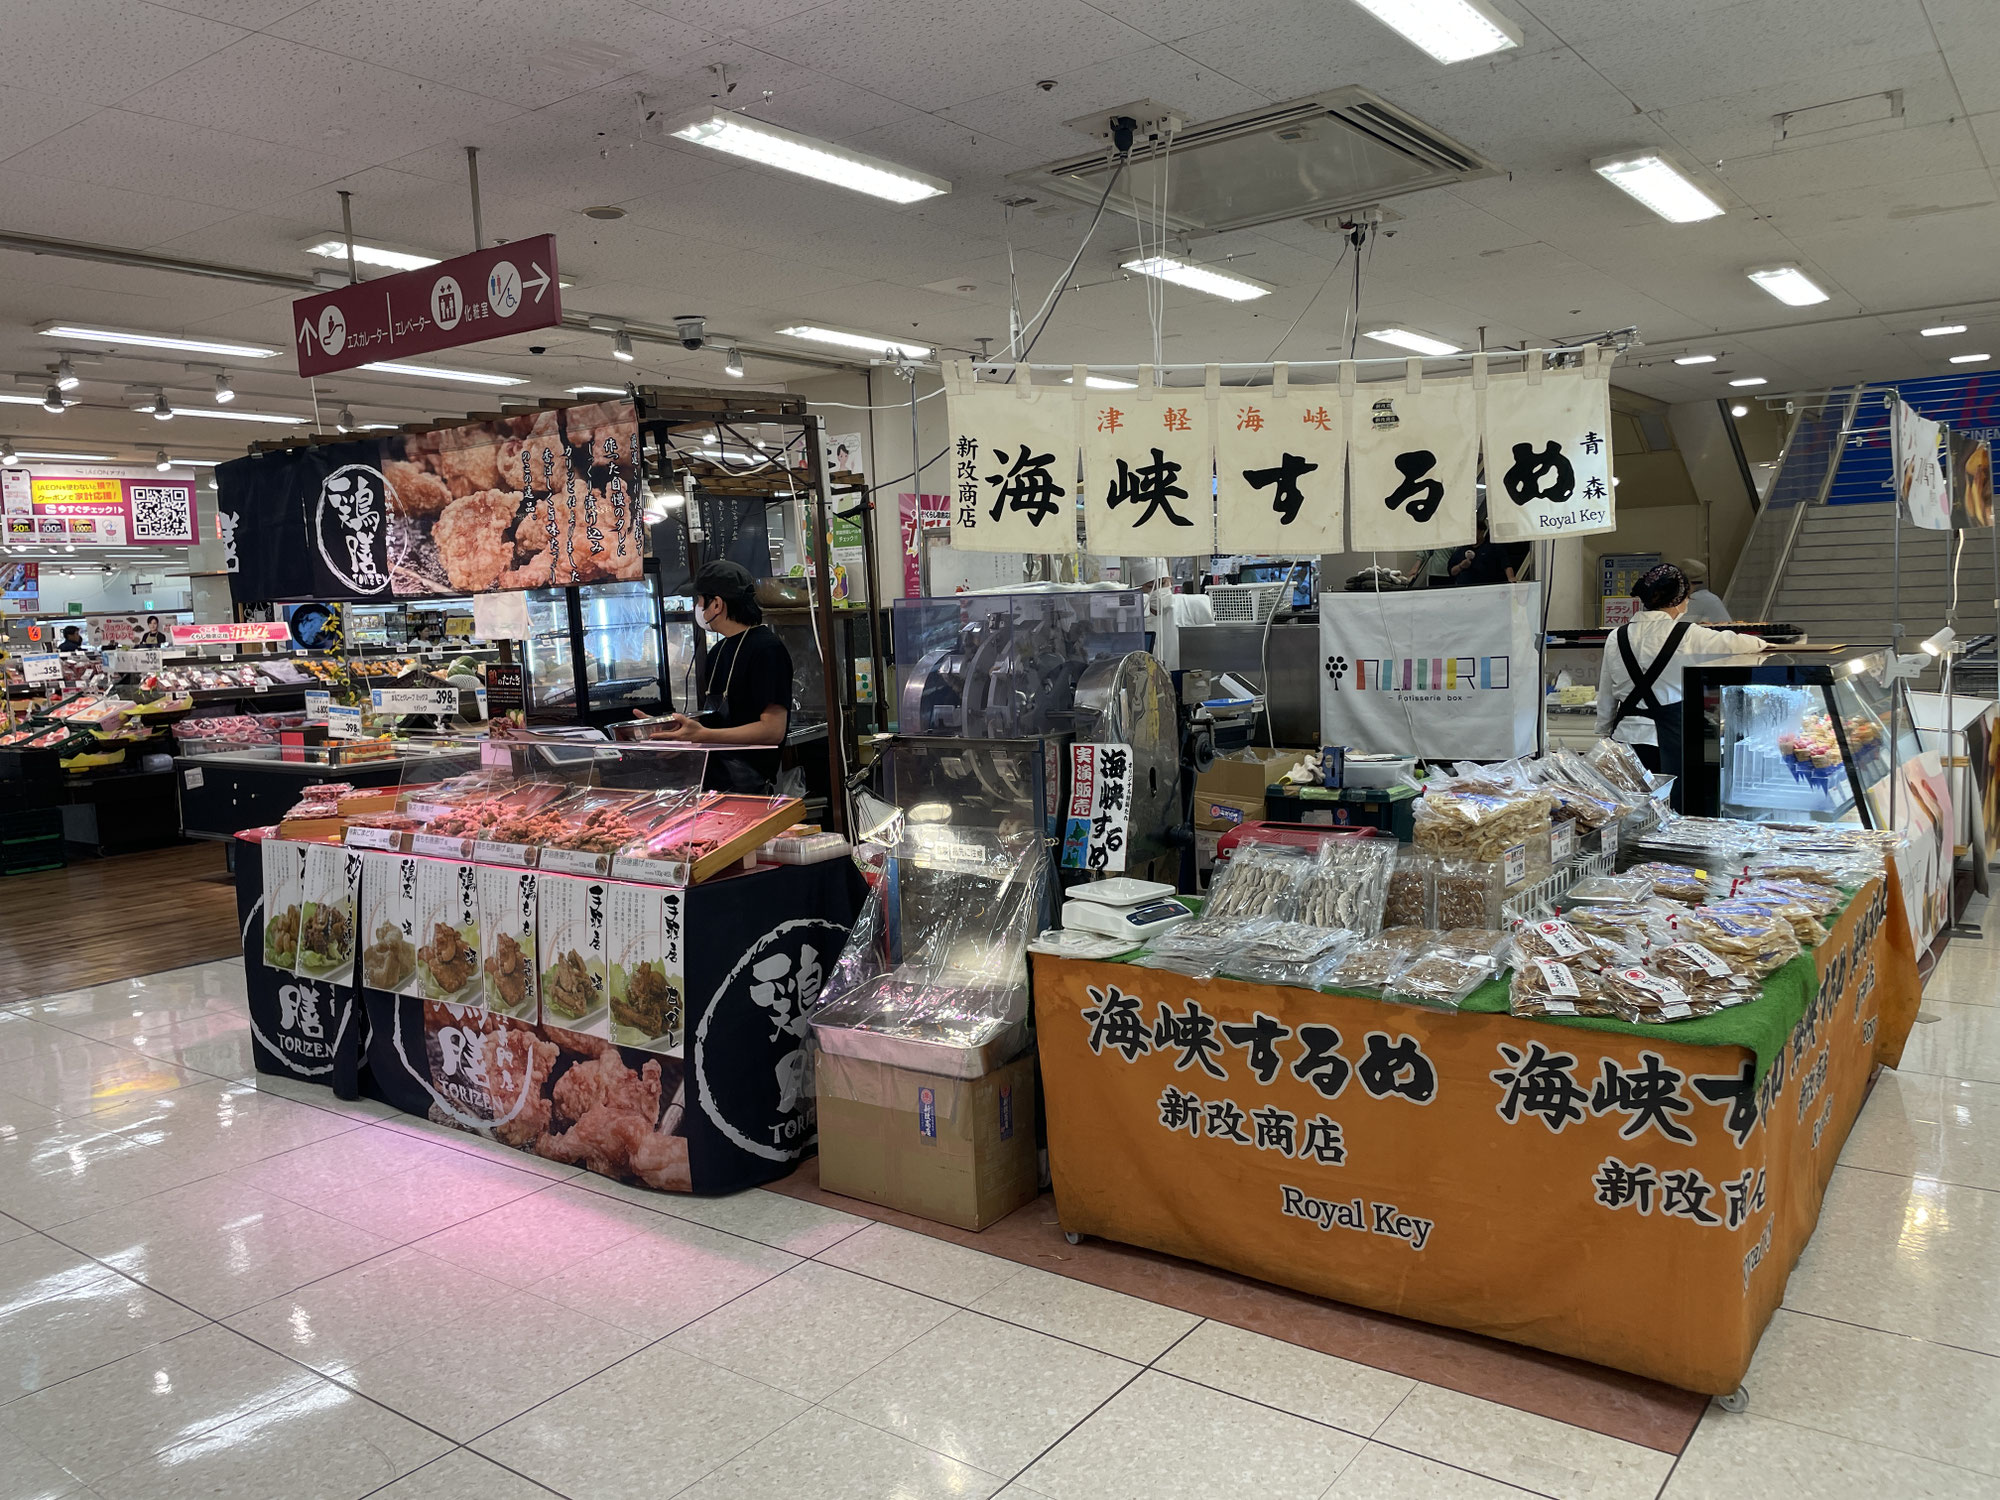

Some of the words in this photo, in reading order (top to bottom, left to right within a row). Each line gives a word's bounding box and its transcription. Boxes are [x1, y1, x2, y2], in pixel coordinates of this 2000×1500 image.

[347, 330, 389, 349] エスカレーター
[395, 318, 431, 336] エレベーター
[464, 302, 489, 322] 化粧室
[1097, 406, 1333, 434] 津軽海峡
[603, 437, 626, 557] 作った自慢のタレに
[955, 435, 979, 528] 新改商店
[985, 441, 1576, 528] 海峡するめ
[1579, 431, 1608, 500] 青森
[1539, 511, 1577, 529] Royal
[1579, 508, 1606, 524] Key
[1447, 694, 1463, 702] box
[1073, 747, 1093, 816] 実演販売
[1087, 748, 1127, 869] 海峡するめ
[458, 866, 476, 927] 鶏もも
[519, 874, 536, 938] 鶏もも
[1081, 984, 1438, 1104] 海峡するめ
[1160, 1086, 1346, 1165] 新改商店
[1280, 1185, 1365, 1231] Royal
[1372, 1203, 1433, 1249] Key
